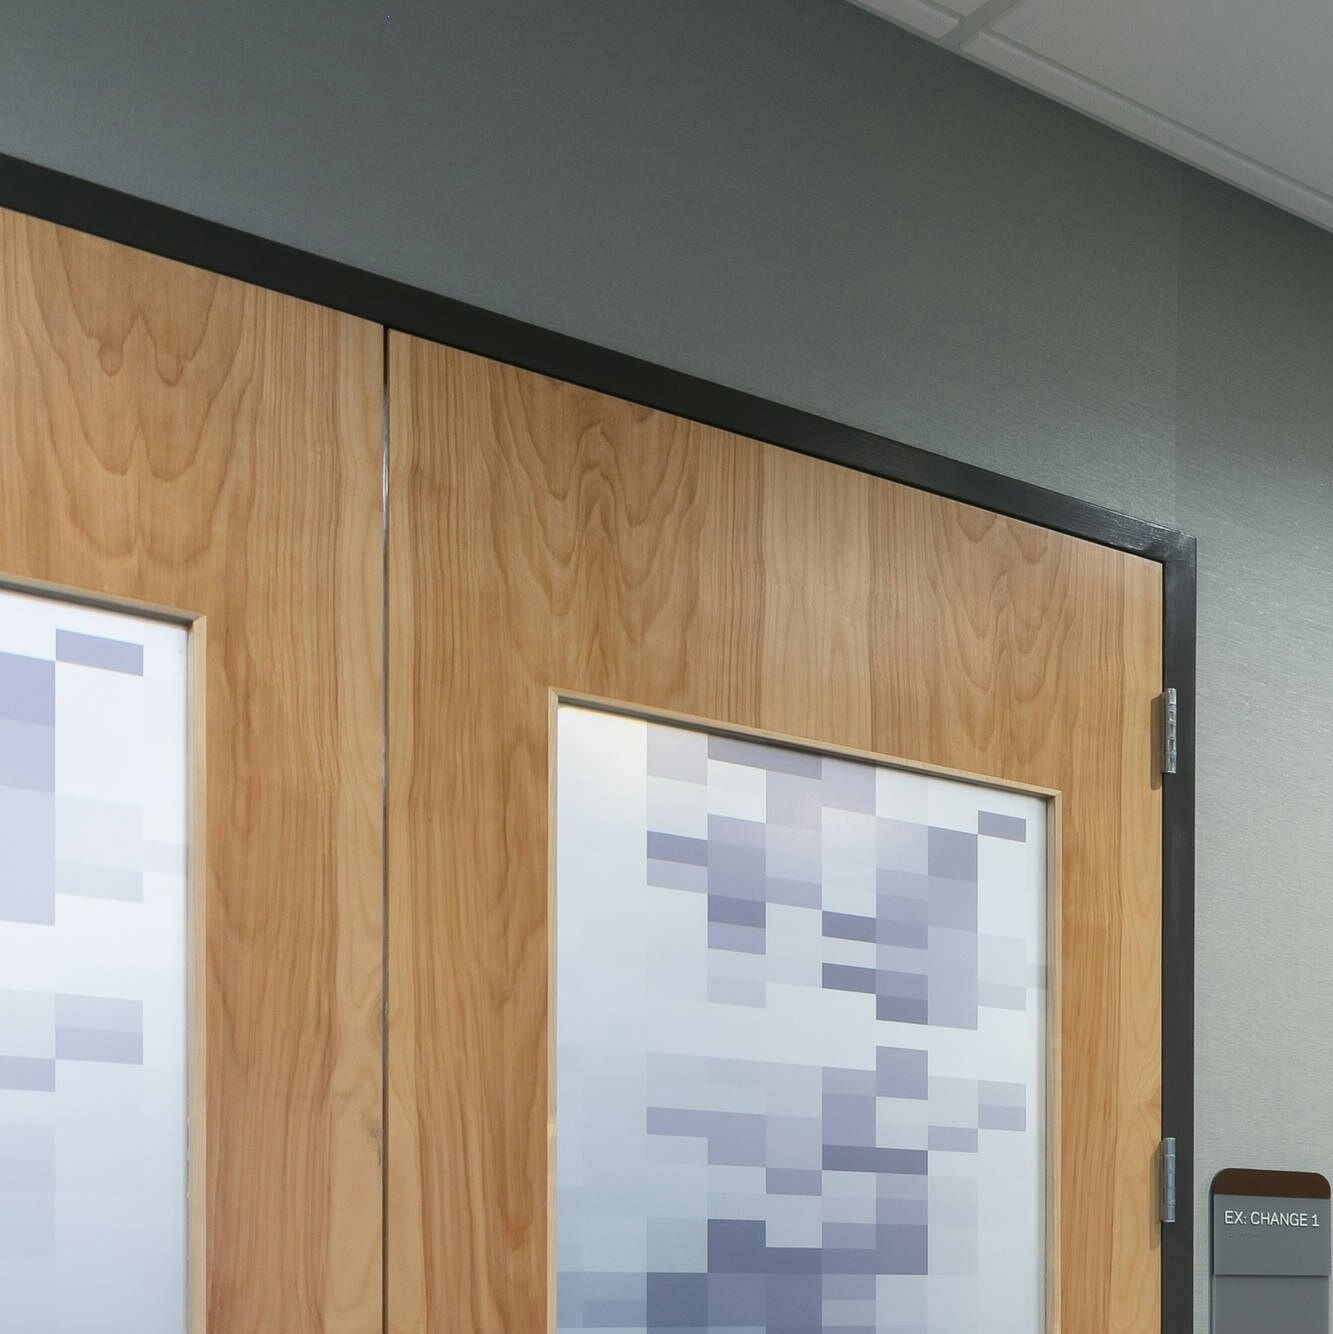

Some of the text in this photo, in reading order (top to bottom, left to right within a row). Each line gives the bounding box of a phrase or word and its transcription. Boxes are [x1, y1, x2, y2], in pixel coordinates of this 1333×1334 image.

[1224, 1210, 1320, 1227] EX: CHANGE 1
